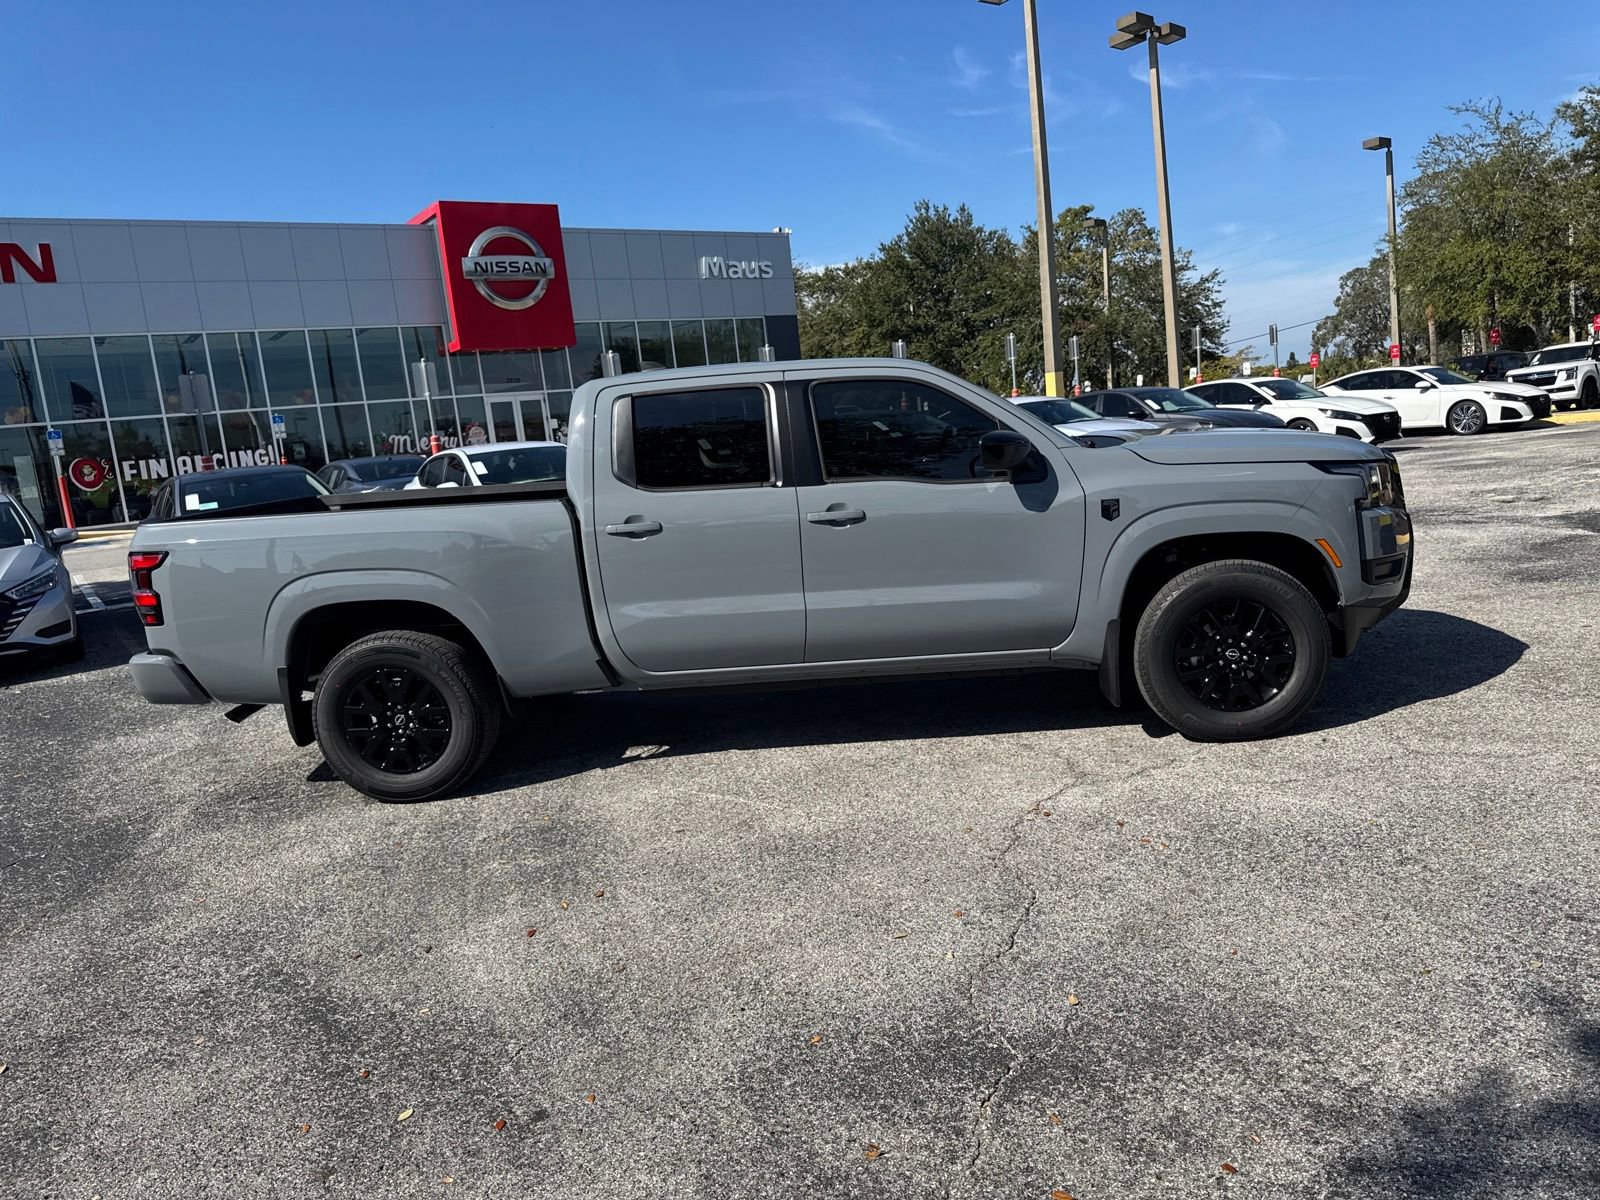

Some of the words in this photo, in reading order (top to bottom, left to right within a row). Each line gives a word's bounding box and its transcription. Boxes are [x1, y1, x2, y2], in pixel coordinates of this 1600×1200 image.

[473, 261, 547, 274] NISSAN
[700, 256, 773, 279] Maus
[389, 434, 458, 454] Mery
